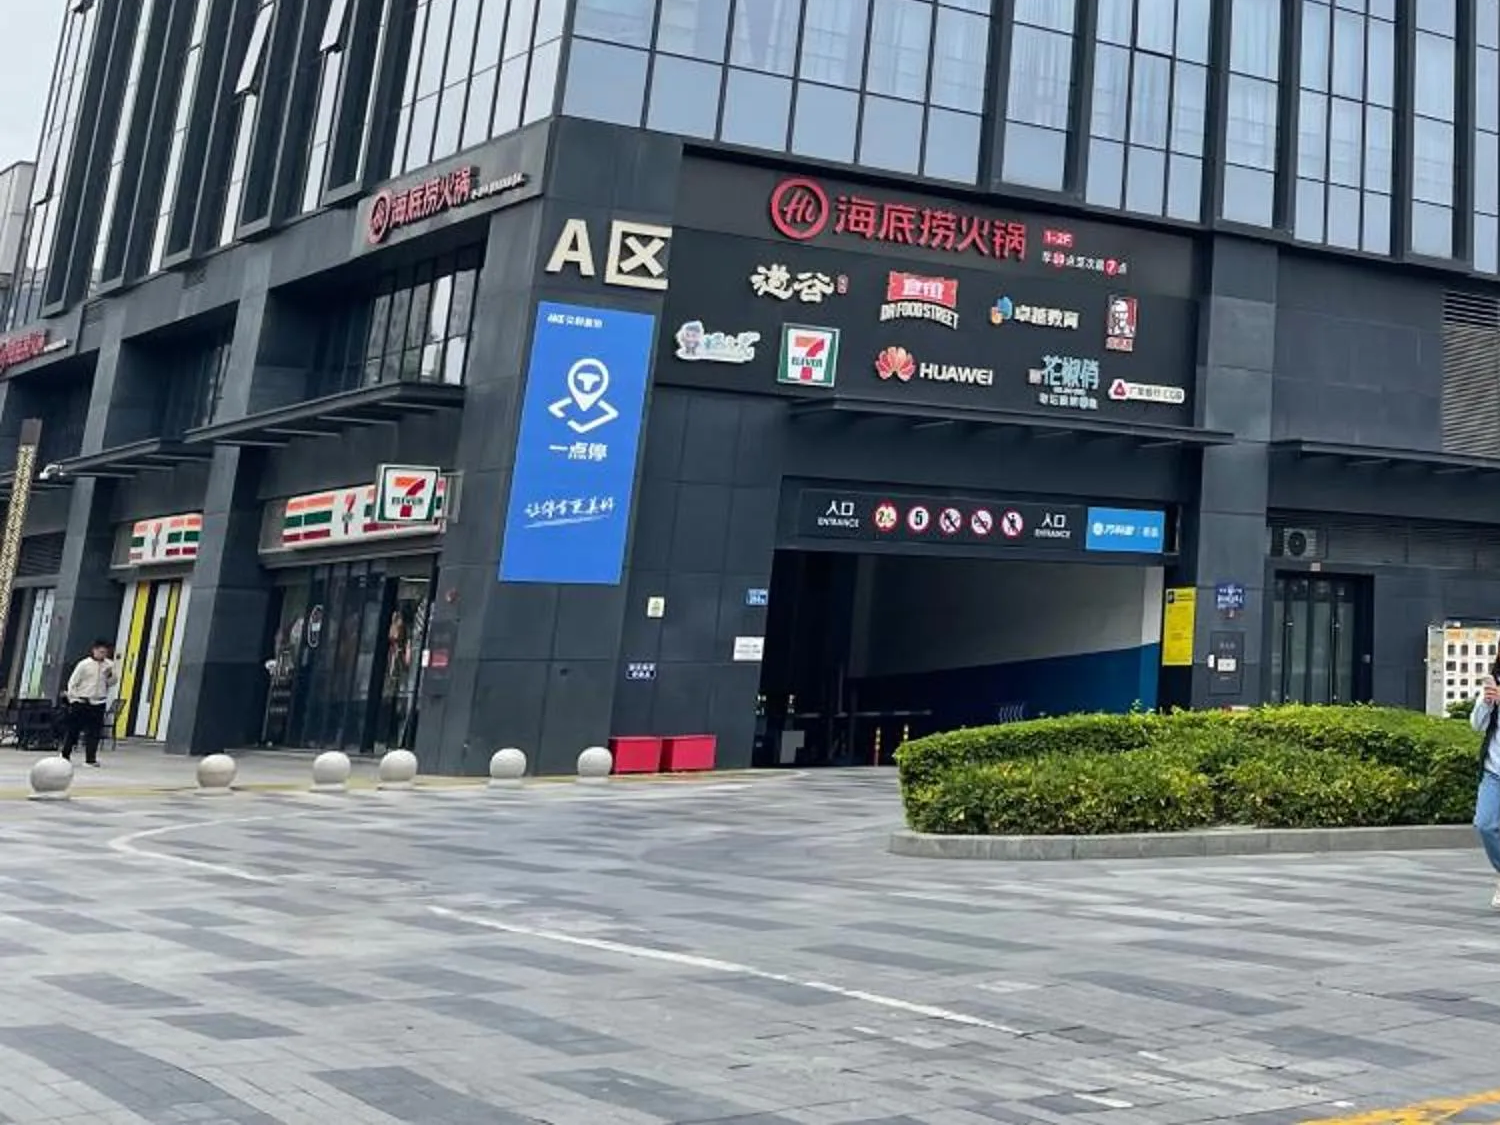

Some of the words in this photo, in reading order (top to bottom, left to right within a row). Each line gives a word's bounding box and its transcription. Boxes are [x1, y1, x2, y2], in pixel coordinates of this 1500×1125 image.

[834, 196, 1027, 261] 海底捞火锅
[545, 218, 673, 290] A区
[1014, 305, 1080, 330] 卓越教育
[919, 362, 993, 386] HUAWEI
[549, 441, 608, 462] 一点停
[826, 500, 855, 516] 入口
[817, 517, 859, 528] ENTRANCE
[915, 510, 924, 526] 5
[1041, 513, 1066, 528] 入口
[1035, 529, 1071, 539] ENTRANCE
